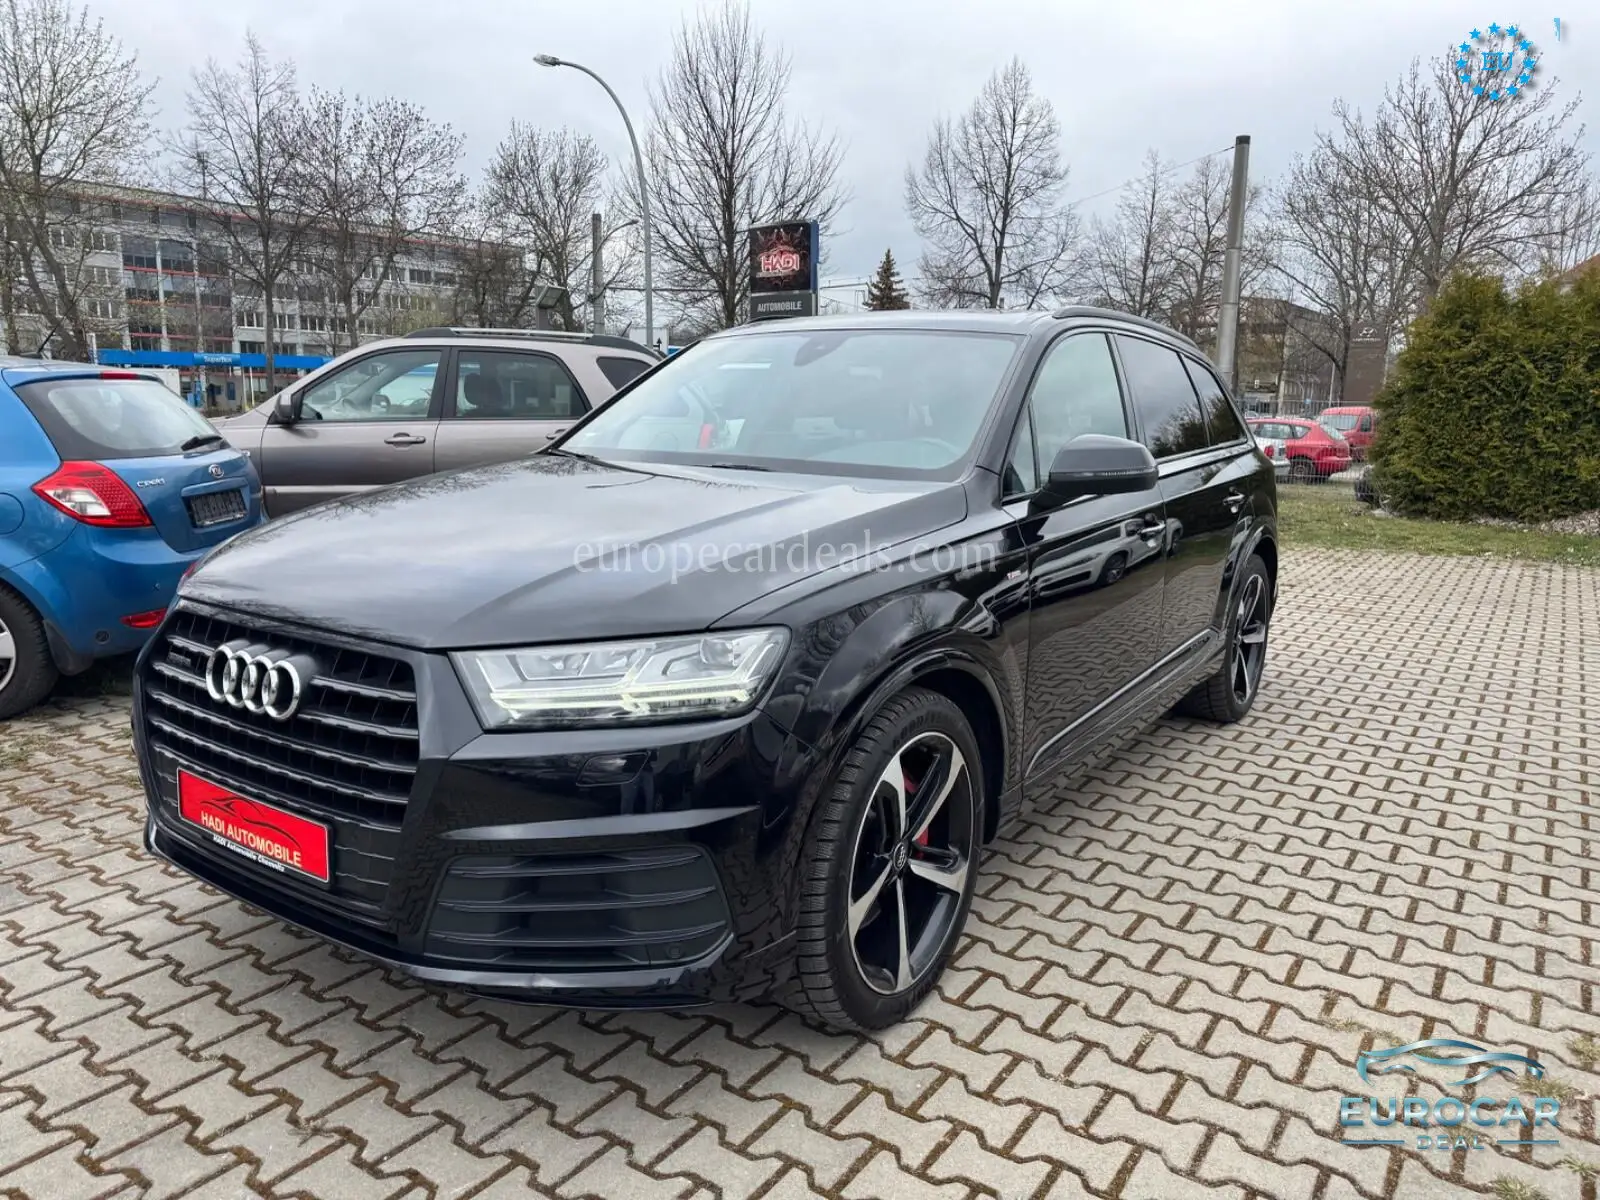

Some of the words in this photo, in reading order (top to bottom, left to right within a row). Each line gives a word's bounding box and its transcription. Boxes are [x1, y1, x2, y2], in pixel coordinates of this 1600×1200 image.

[761, 253, 800, 273] HADI
[757, 301, 803, 312] AUTOMOBILE
[201, 811, 226, 834] HADI
[227, 824, 302, 868] AUTOMOBILE
